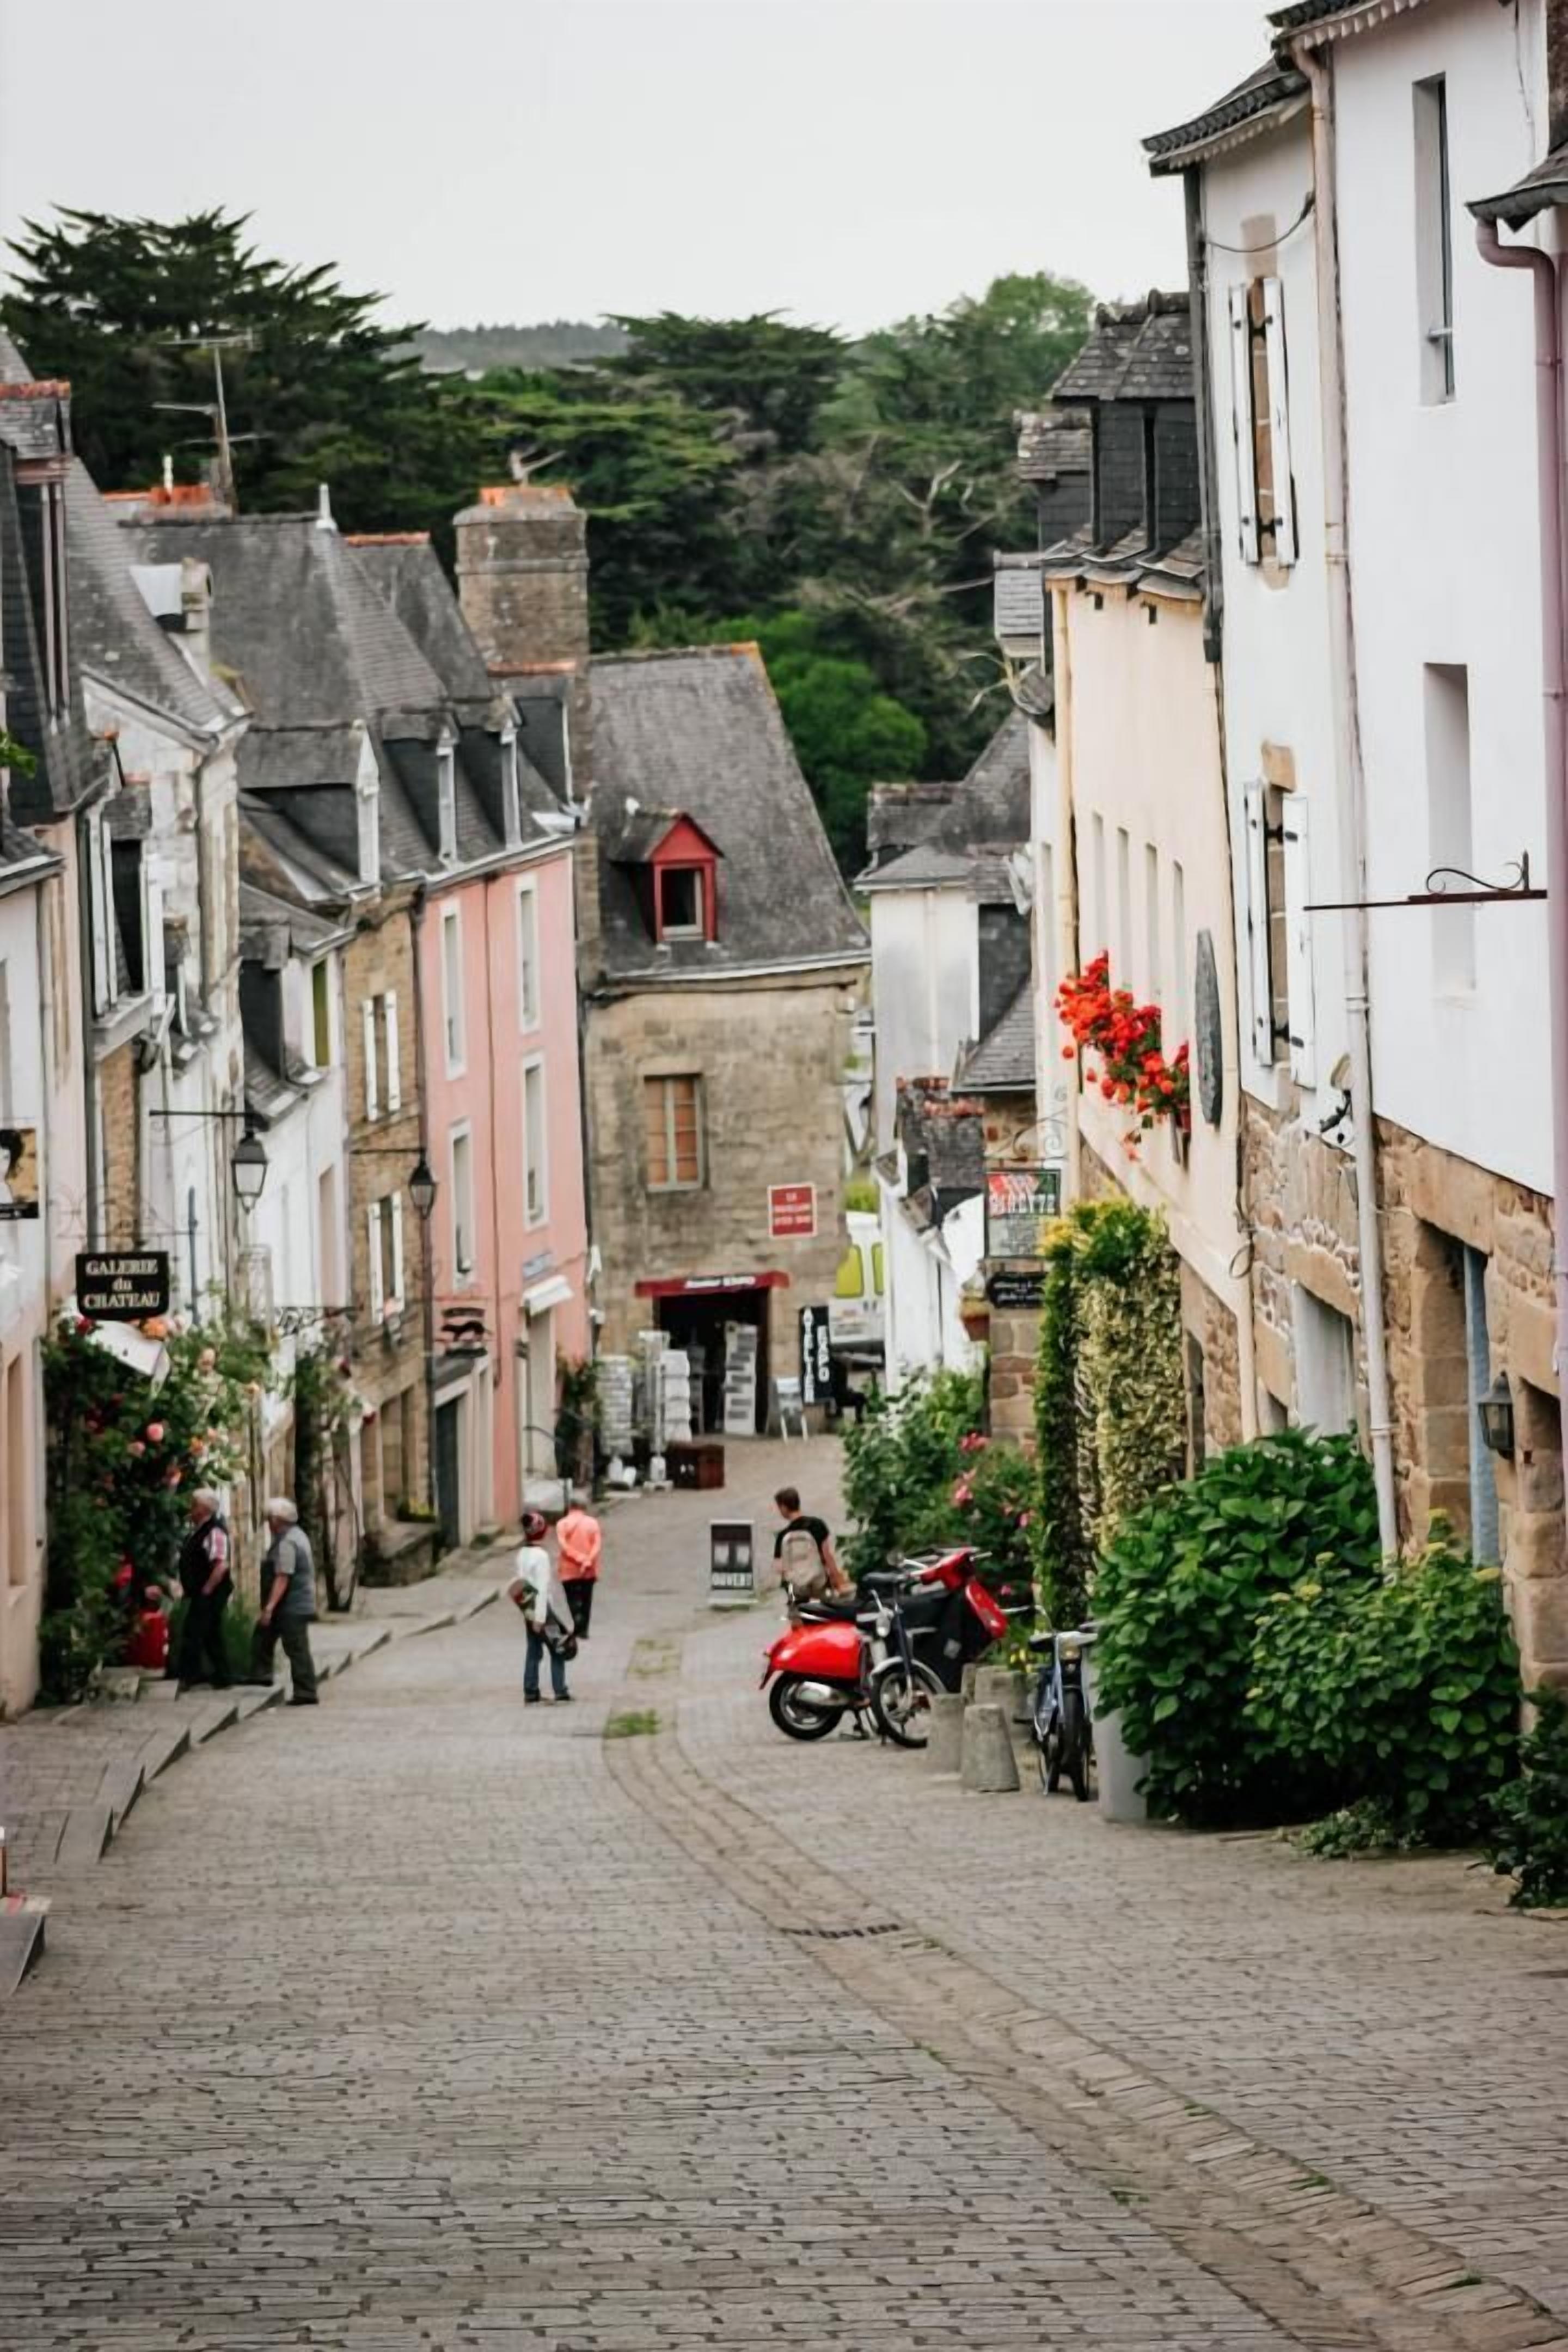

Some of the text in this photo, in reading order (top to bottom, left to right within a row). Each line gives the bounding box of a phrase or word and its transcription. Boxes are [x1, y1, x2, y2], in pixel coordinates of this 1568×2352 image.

[85, 1259, 158, 1275] GALERIE
[112, 1277, 132, 1291] du
[817, 1325, 830, 1383] EXPO
